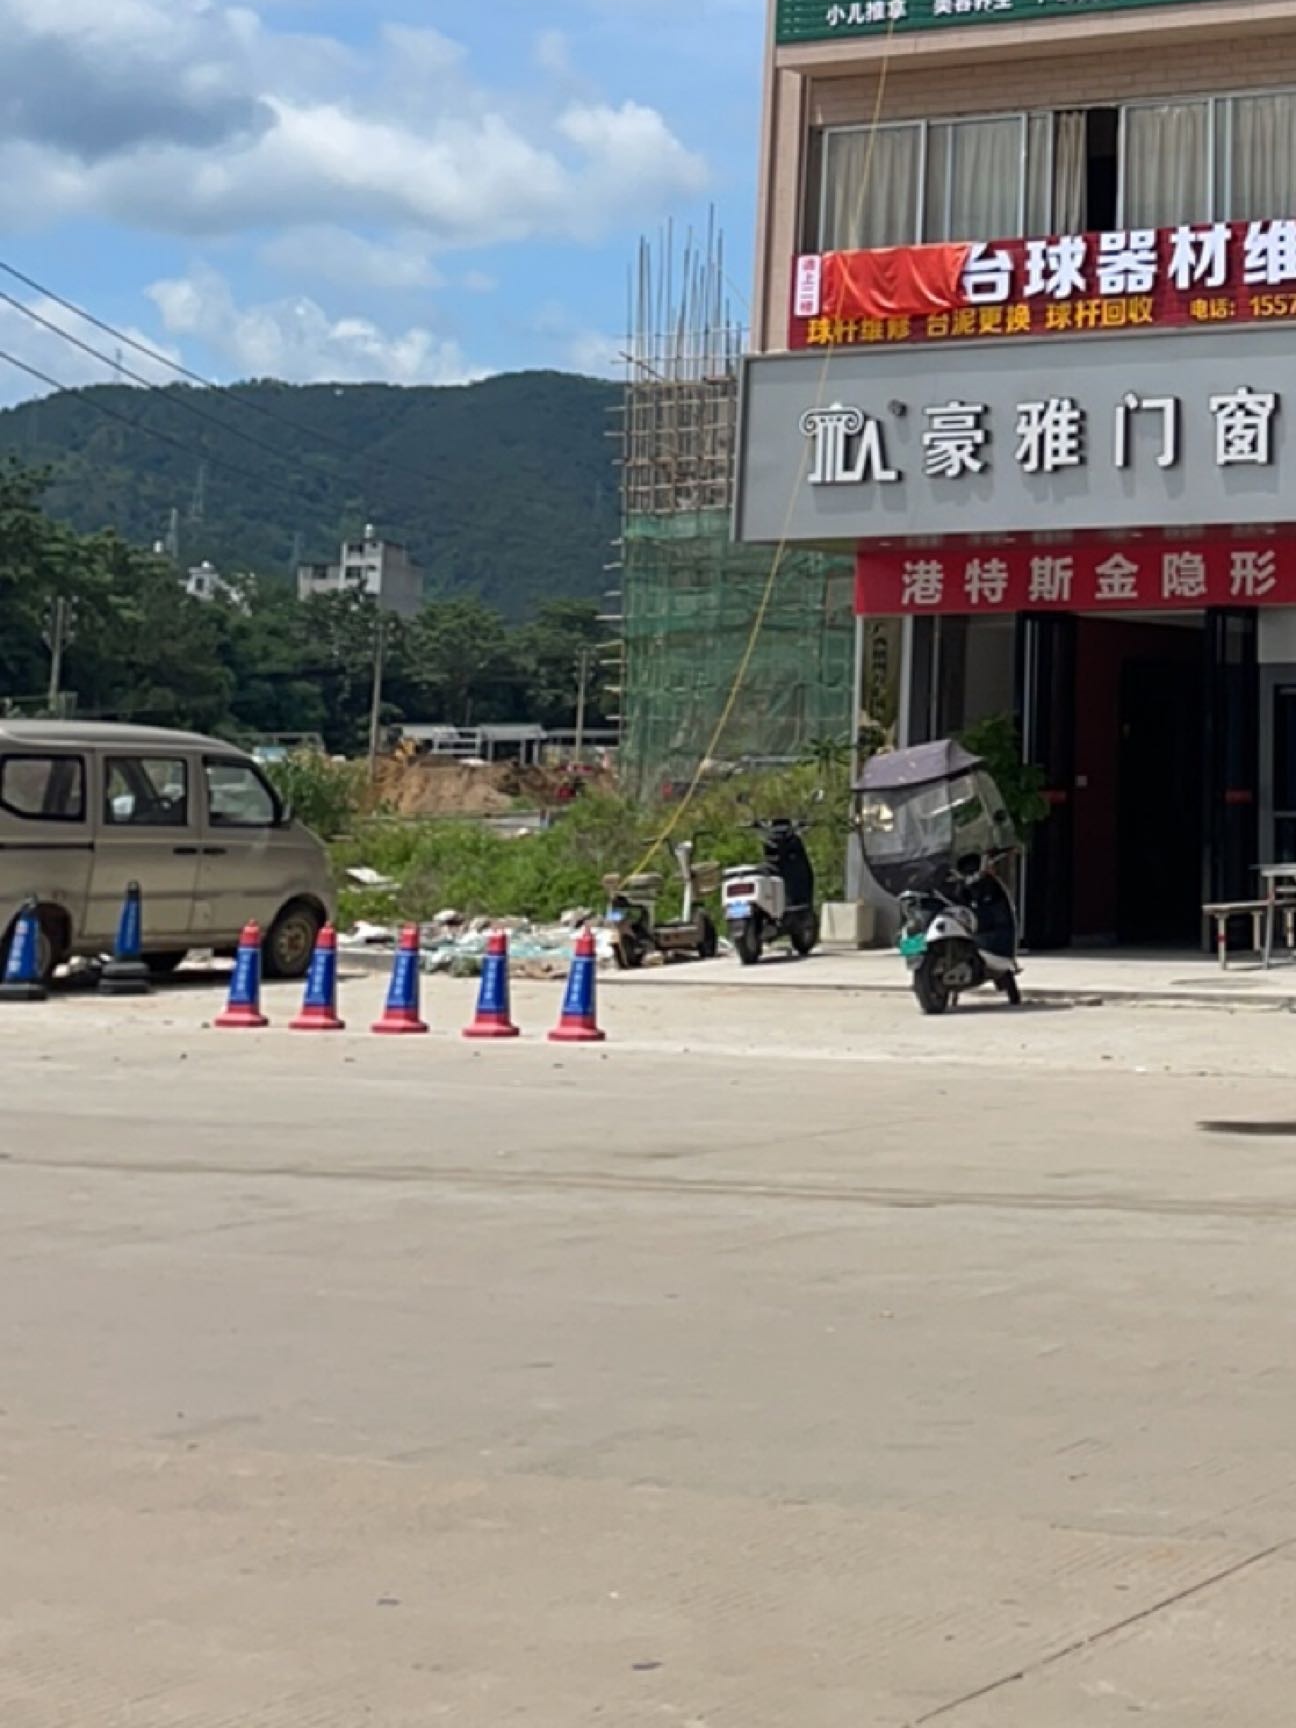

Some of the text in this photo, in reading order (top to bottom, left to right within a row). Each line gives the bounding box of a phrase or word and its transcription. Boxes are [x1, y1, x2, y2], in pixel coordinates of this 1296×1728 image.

[1046, 292, 1153, 329] 球杆回收
[922, 386, 1278, 479] 豪雅门窗
